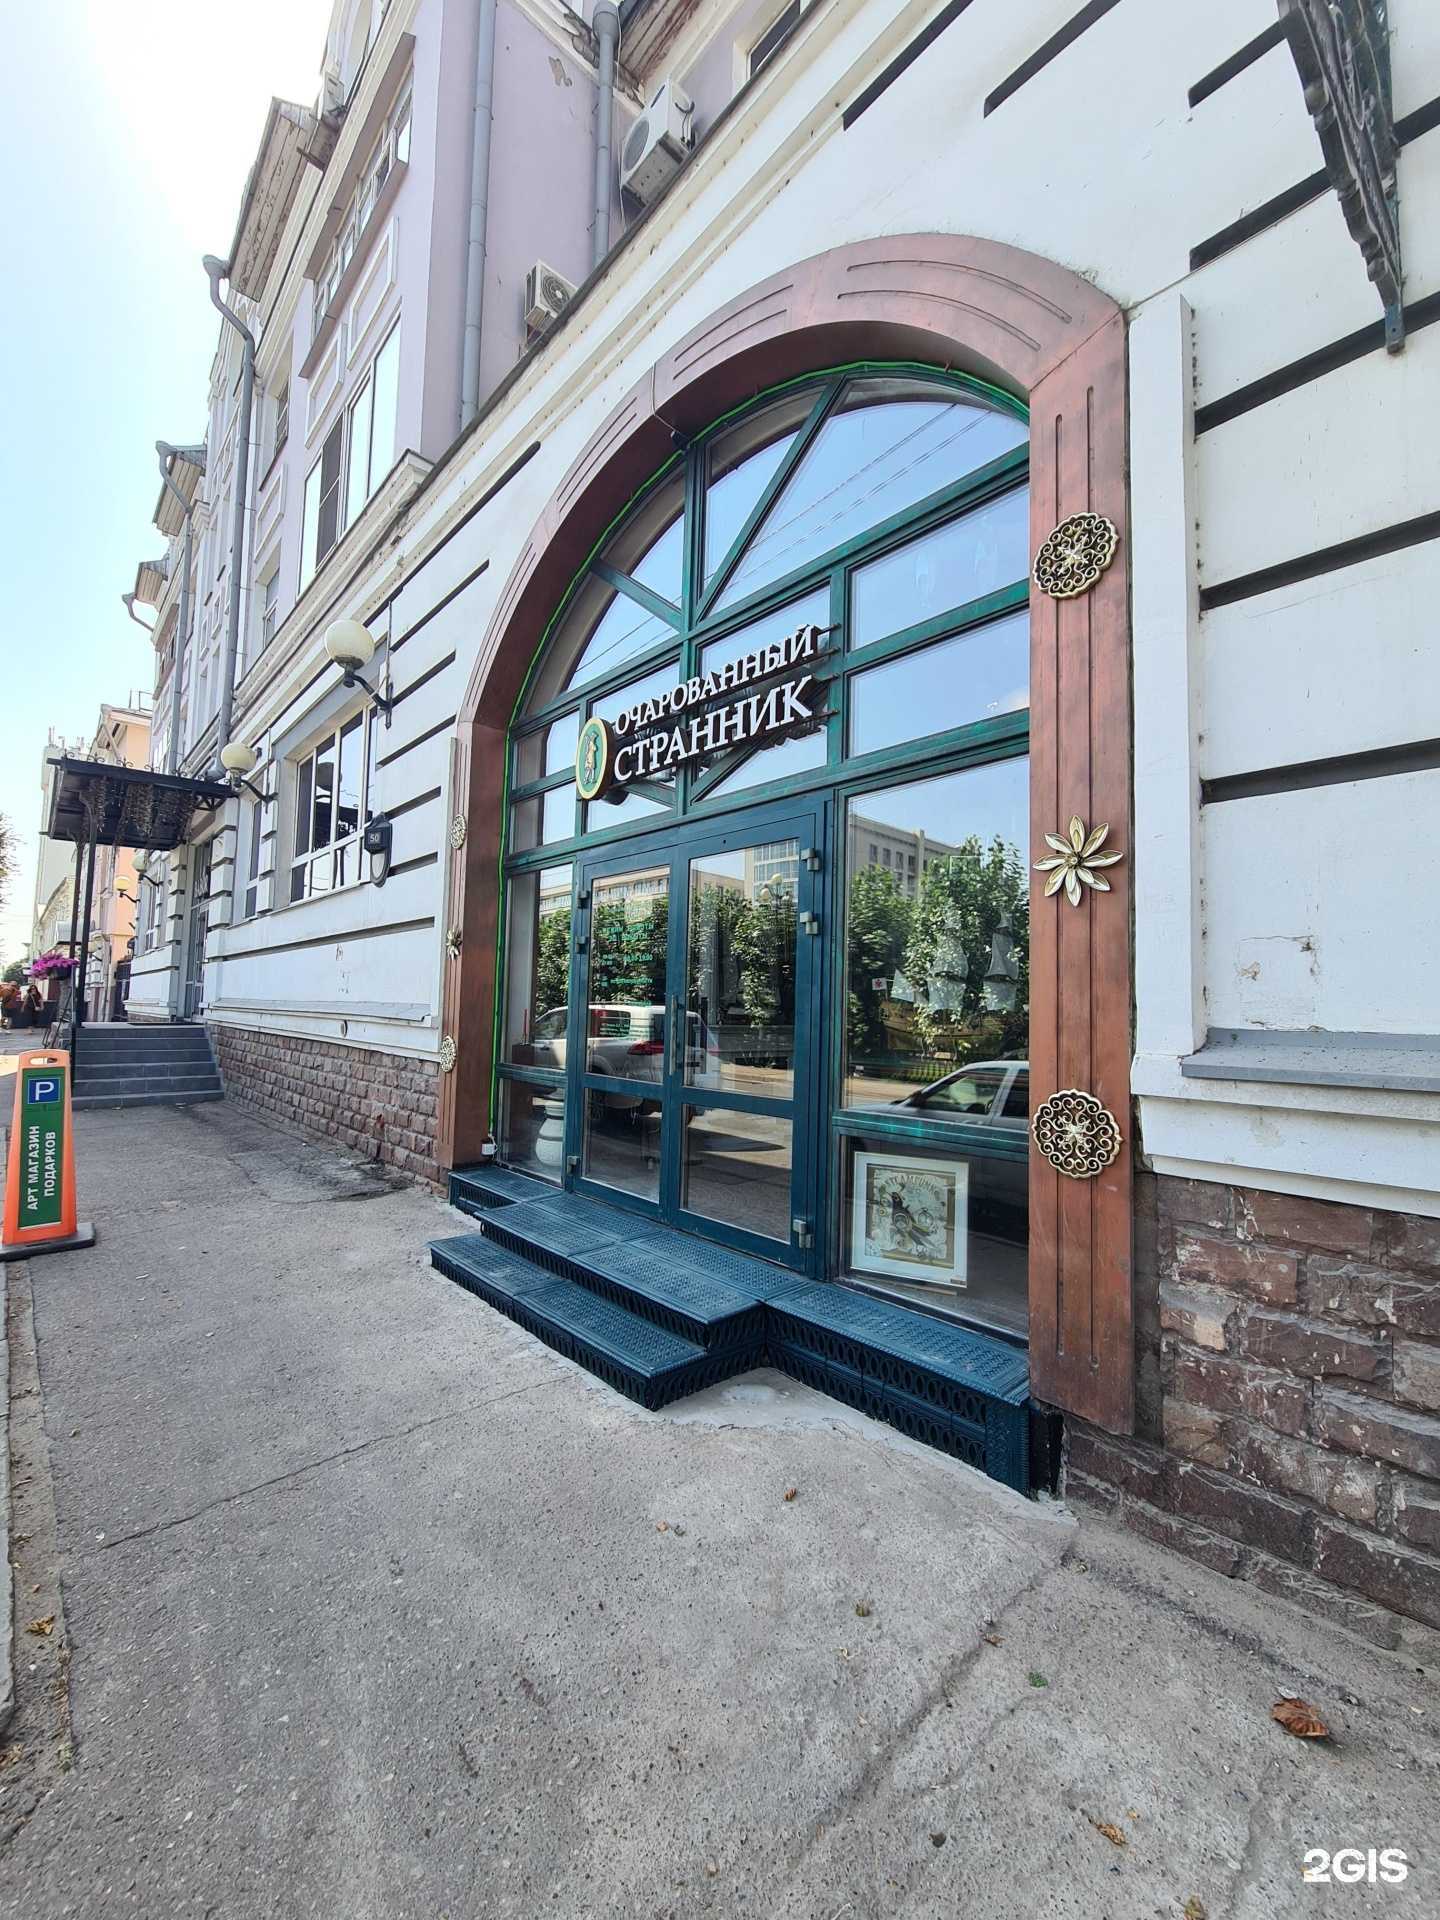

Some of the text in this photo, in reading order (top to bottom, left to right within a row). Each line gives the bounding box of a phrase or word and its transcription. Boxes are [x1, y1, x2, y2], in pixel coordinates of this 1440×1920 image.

[614, 623, 816, 736] ОЧАРОВАННЫЙ
[614, 674, 814, 782] СТРАННИК
[371, 833, 379, 842] 50
[27, 1125, 40, 1211] АРТ МАГАЗИН
[44, 1131, 56, 1197] ПОДАРКОВ
